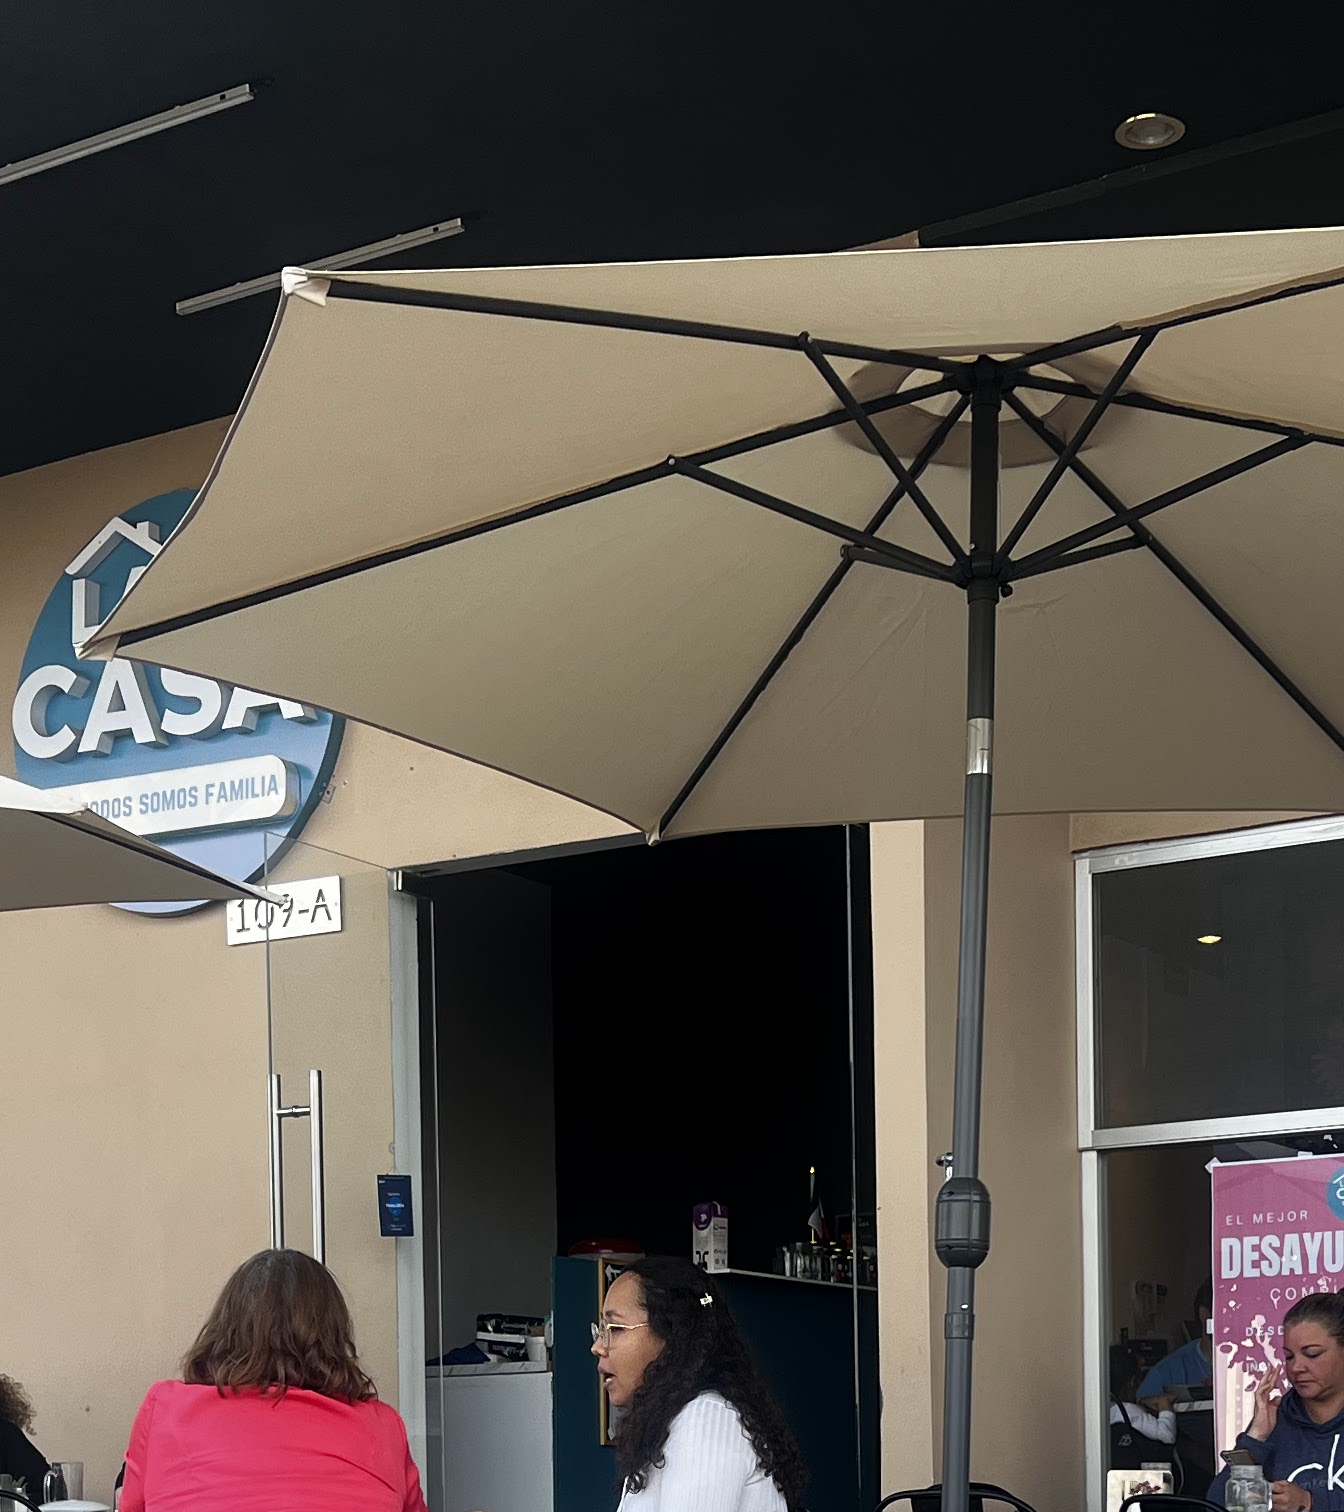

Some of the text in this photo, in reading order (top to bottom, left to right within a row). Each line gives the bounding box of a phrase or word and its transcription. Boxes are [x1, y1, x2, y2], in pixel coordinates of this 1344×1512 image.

[88, 774, 279, 820] ODOS SOMOS FAMILIA
[1226, 1210, 1308, 1226] EL MEJOR
